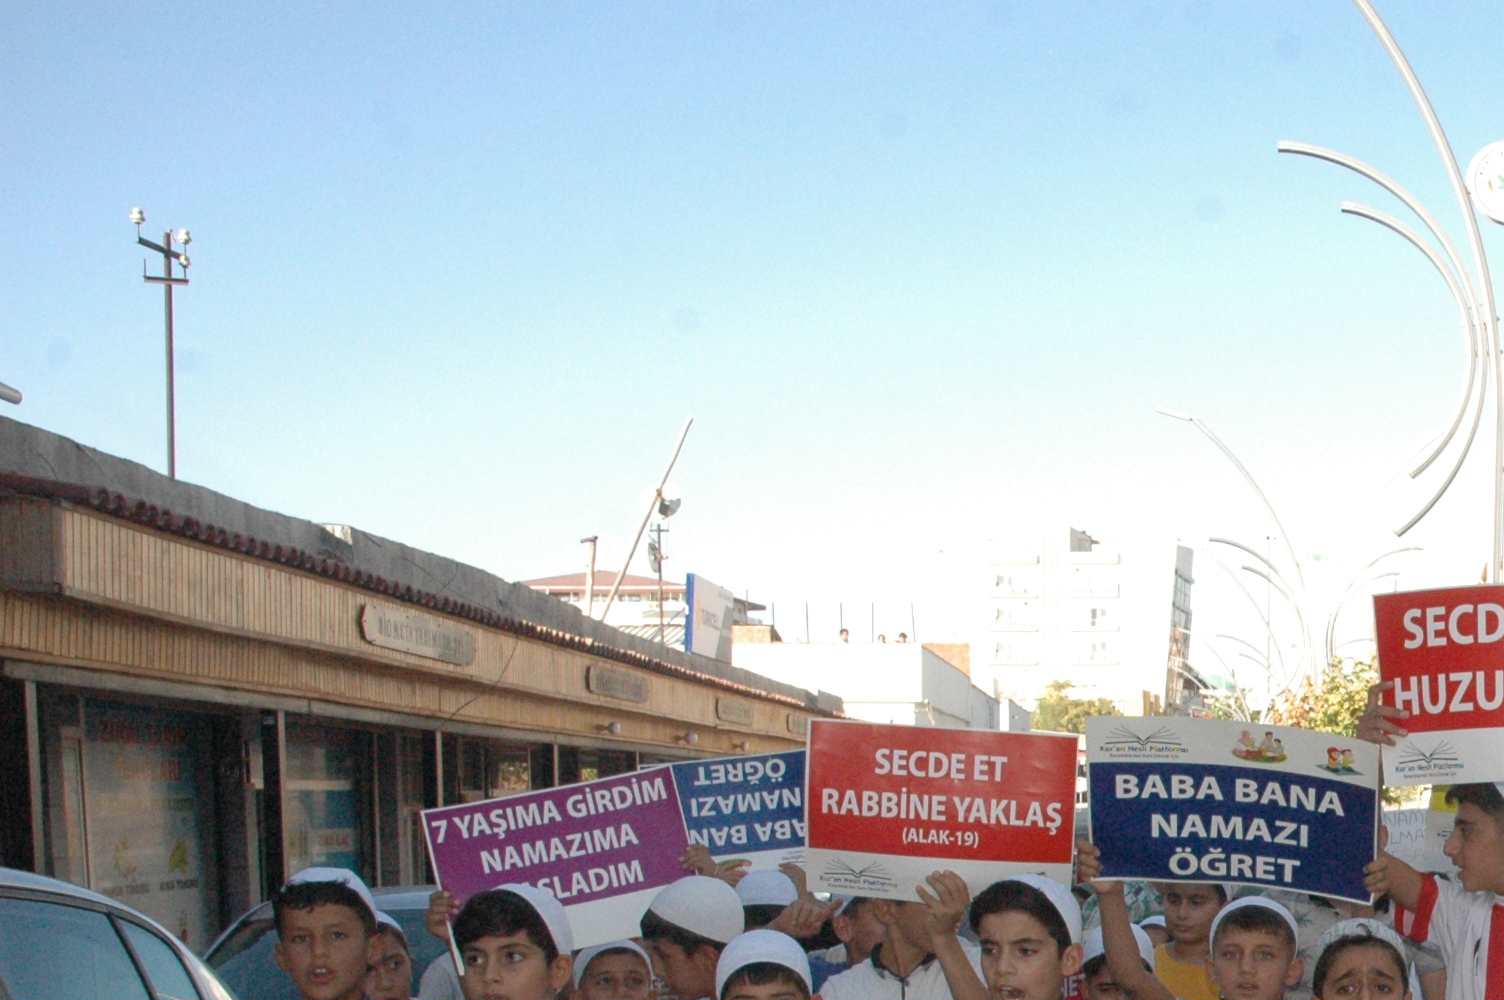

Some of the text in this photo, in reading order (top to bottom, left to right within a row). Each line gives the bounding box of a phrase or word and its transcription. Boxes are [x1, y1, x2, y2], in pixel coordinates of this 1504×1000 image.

[694, 758, 786, 786] ÖĞRET
[874, 747, 1008, 783] SECDE ET
[431, 777, 668, 844] 7 YAŞIMA GİRDİM
[690, 787, 802, 818] NAMAZI
[822, 787, 1062, 835] RABBİNE YAKLAŞ
[1114, 774, 1345, 817] BABA BANA
[689, 819, 806, 848] ABA BAN
[1151, 813, 1308, 848] NAMAZI
[1384, 811, 1428, 827] NAM
[481, 823, 639, 874] NAMAZIMA
[902, 828, 979, 849] (ALAK-19)
[521, 859, 645, 900] SLADIM
[1169, 846, 1301, 883] ÖĞRET
